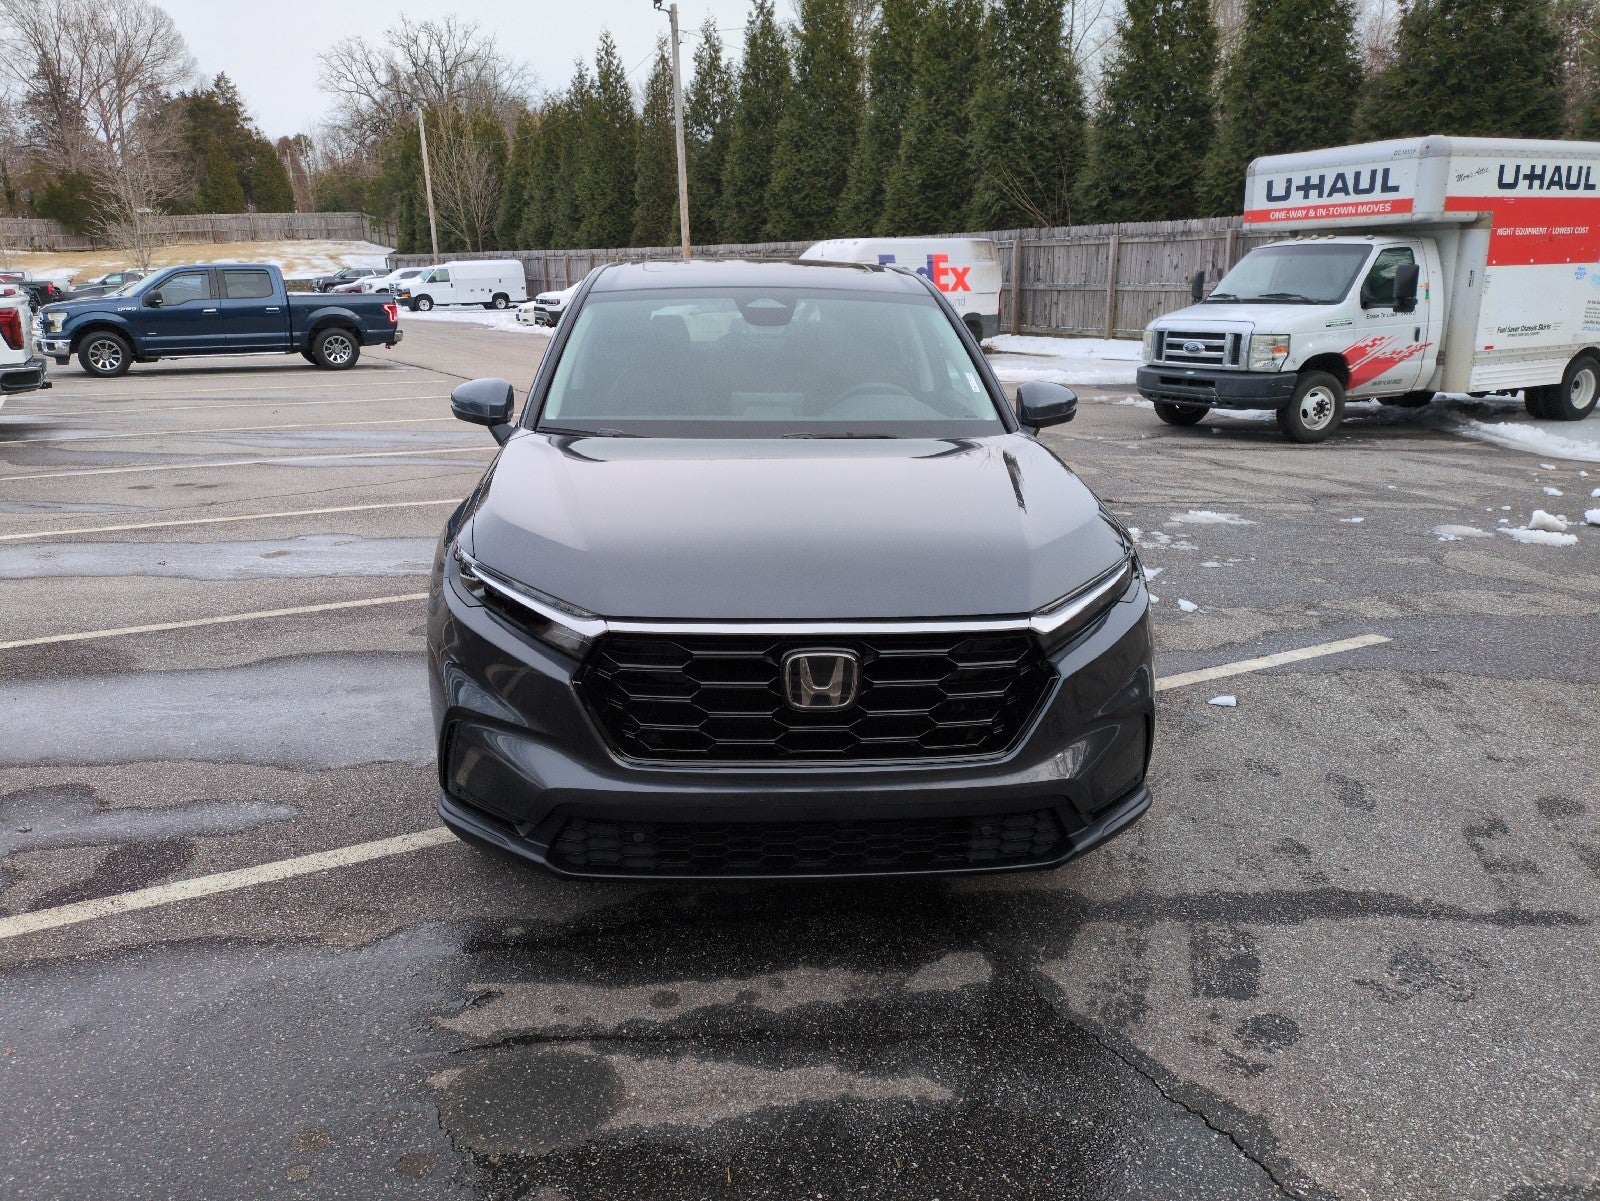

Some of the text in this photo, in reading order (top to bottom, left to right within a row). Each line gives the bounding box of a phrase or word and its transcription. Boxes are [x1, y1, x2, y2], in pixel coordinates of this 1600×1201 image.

[1265, 167, 1400, 202] U-HAUL
[1497, 164, 1597, 191] U-HAUL
[1270, 202, 1392, 220] ONE-WAY & IN-TOWN MOVES
[1496, 228, 1514, 236] RIGHT
[1515, 227, 1548, 235] EQUIPMENT
[1552, 227, 1575, 235] LOWEST
[1574, 226, 1589, 234] COST
